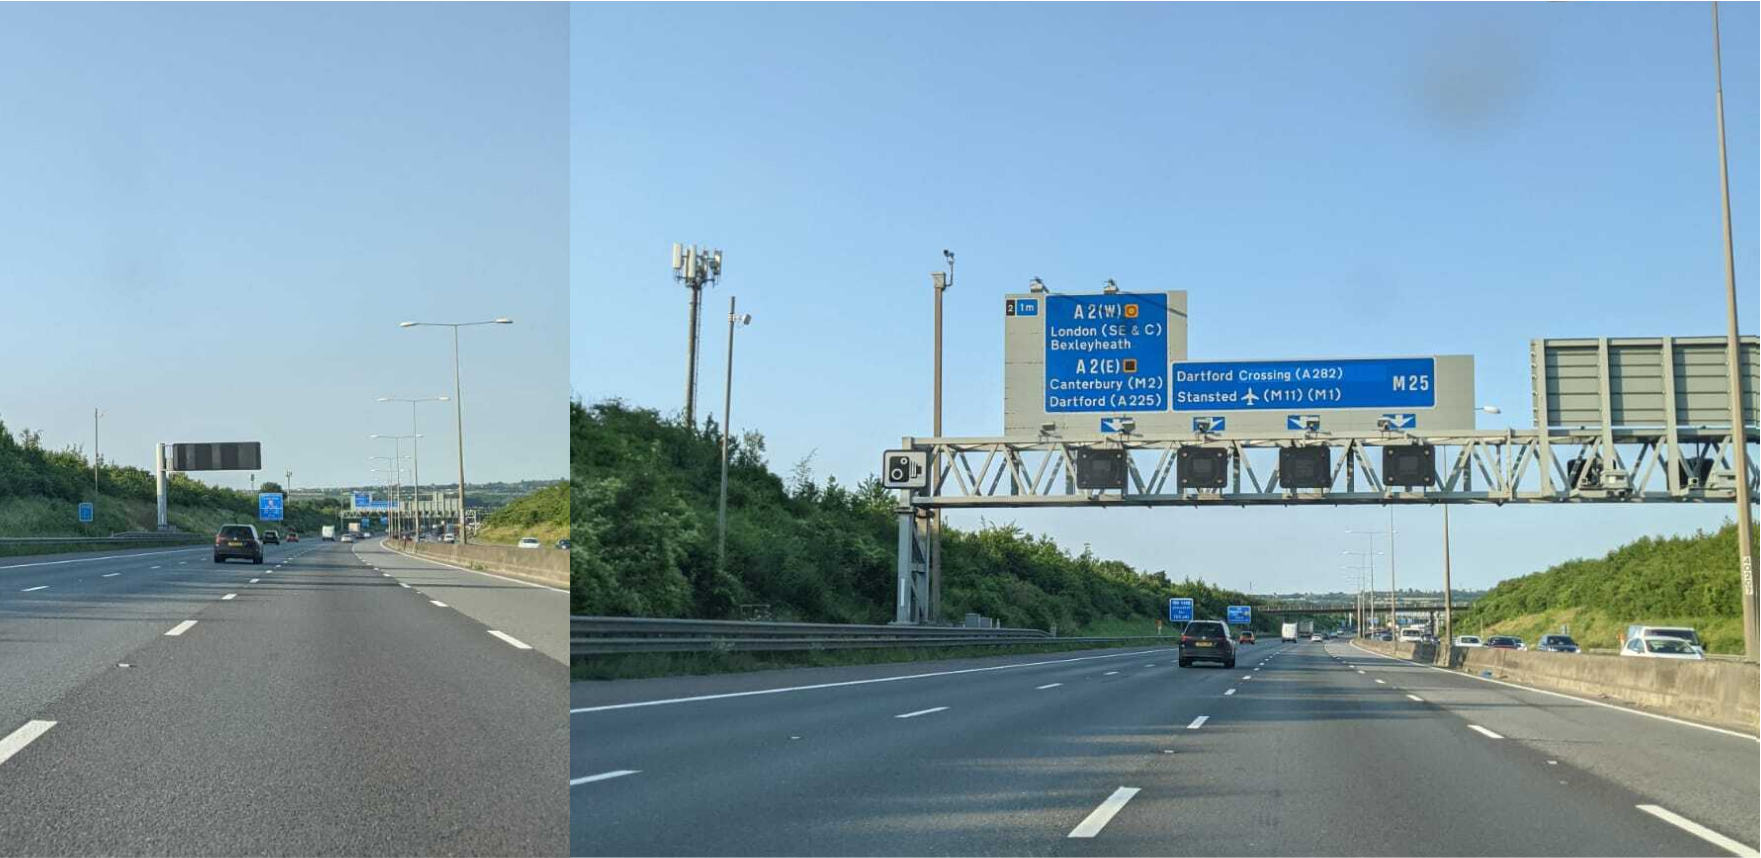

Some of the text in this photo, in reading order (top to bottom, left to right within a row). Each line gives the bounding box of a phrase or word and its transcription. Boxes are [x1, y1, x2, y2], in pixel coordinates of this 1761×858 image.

[1008, 304, 1035, 312] 2 1m
[1051, 323, 1162, 337] London (SE & C)
[1051, 339, 1131, 352] Bexleyheath
[1177, 370, 1233, 382] Dartford
[1239, 369, 1291, 382] Crossing
[1050, 376, 1163, 391] Canterbury (M2)
[1050, 395, 1106, 407] Dartford
[1178, 388, 1342, 403] Stansted (M11) (M1)
